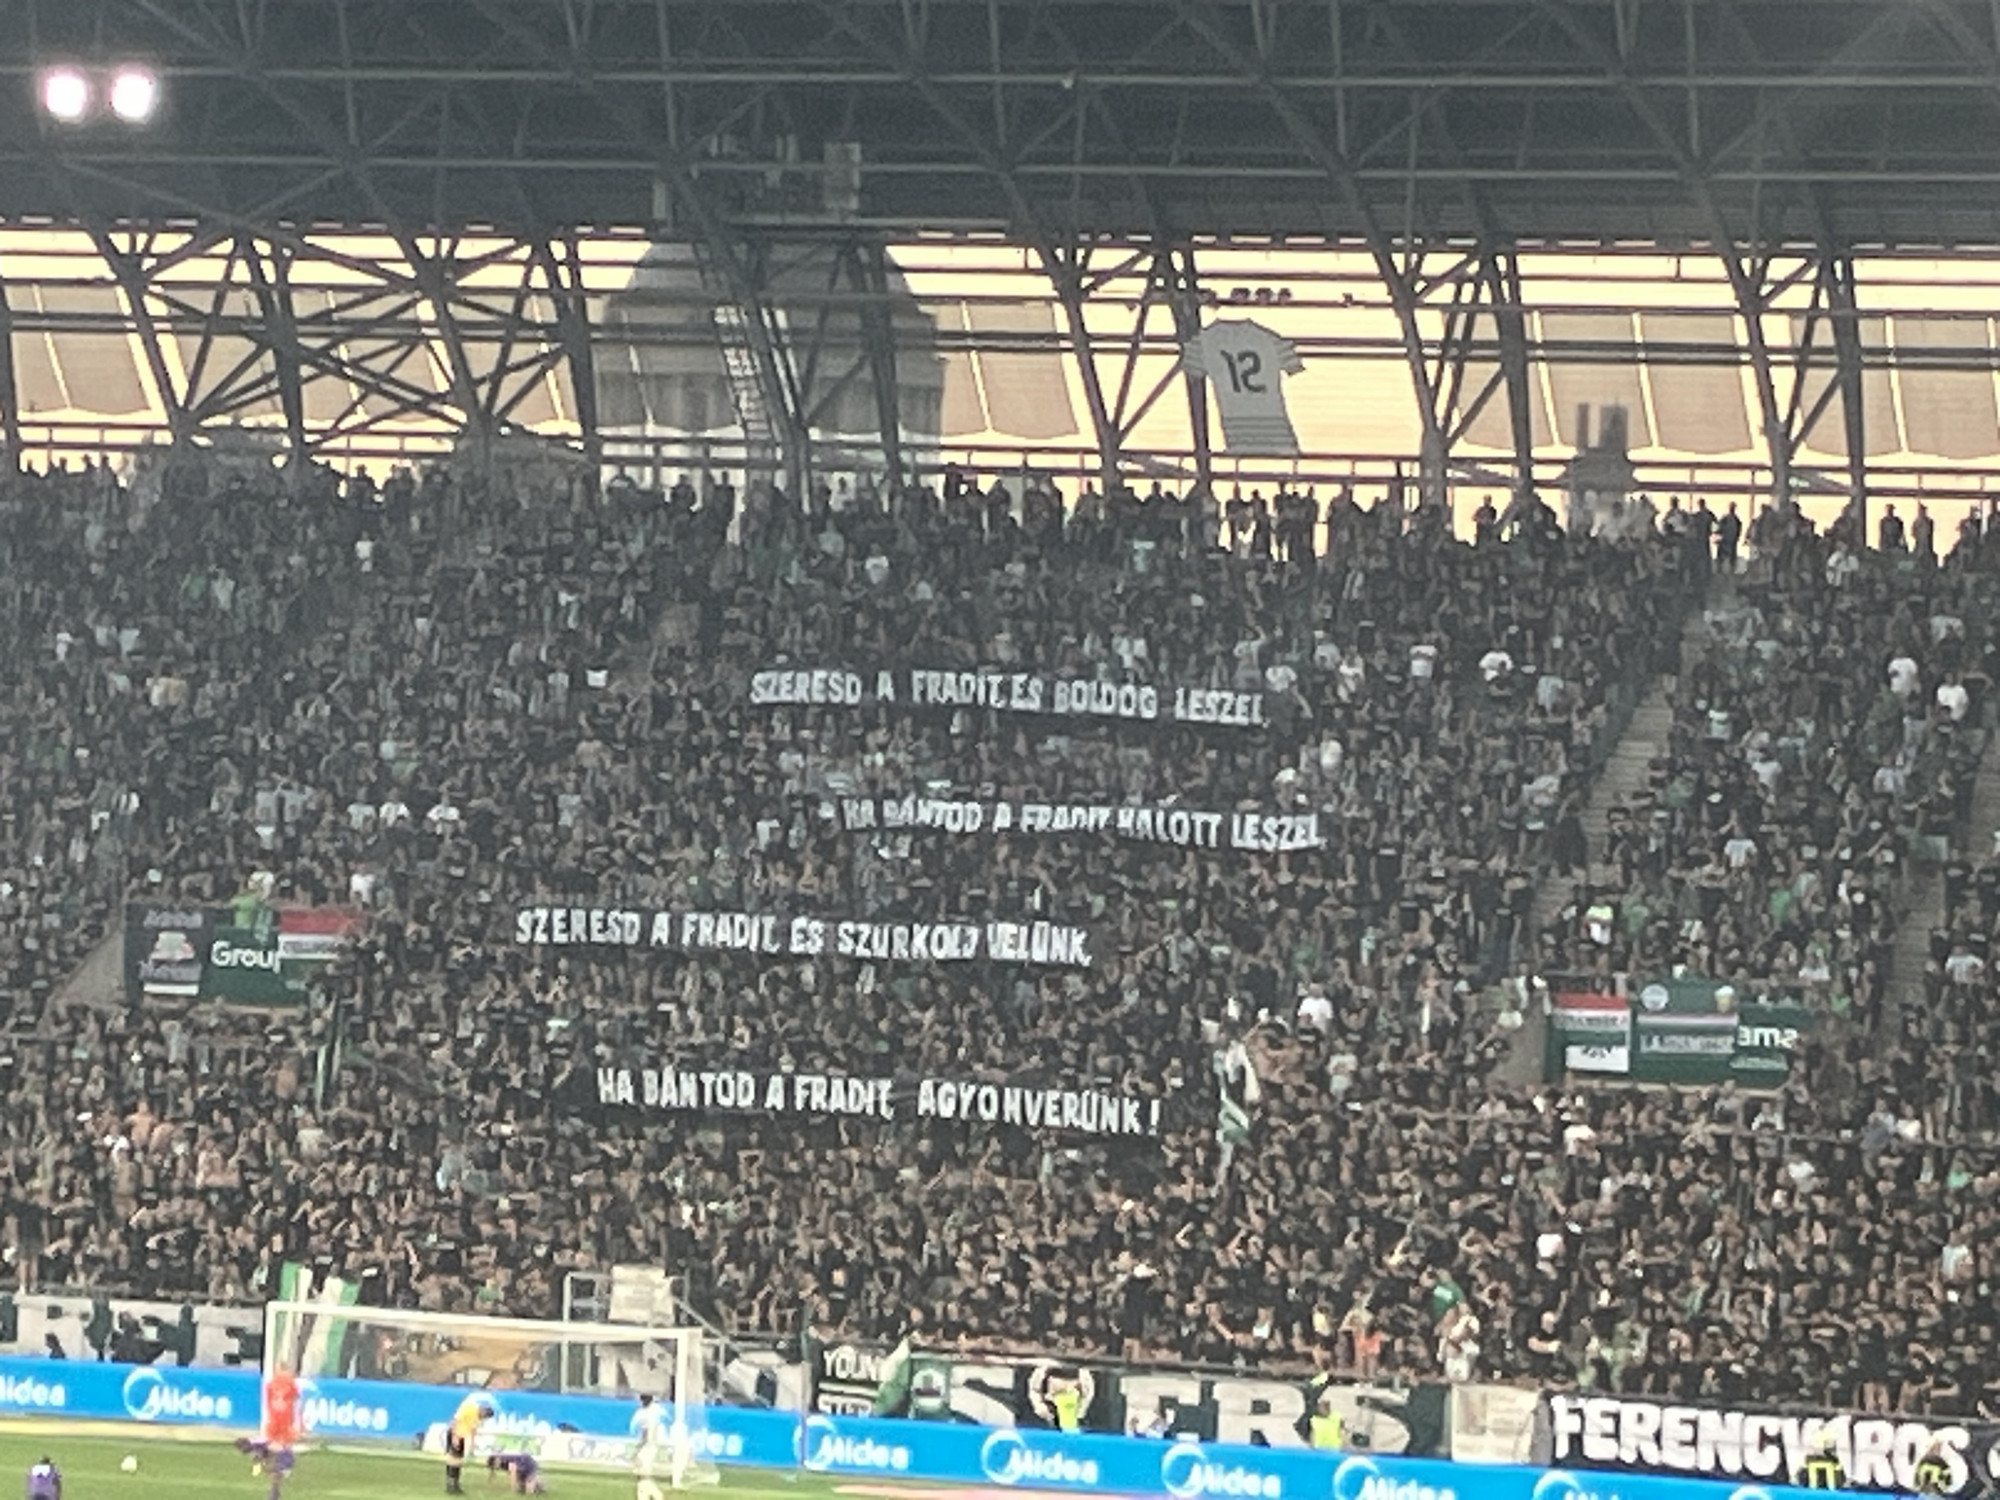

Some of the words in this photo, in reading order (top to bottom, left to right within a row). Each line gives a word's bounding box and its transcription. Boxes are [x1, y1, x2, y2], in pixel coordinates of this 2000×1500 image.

[1221, 350, 1266, 393] 12
[751, 670, 862, 704] SZERESD
[876, 671, 896, 701] A
[1054, 680, 1158, 718] BOLDOG
[993, 802, 1012, 833] A
[516, 908, 641, 945] SZERESD
[650, 911, 670, 946] A
[598, 1067, 635, 1105] HA
[764, 1075, 784, 1111] A
[148, 1384, 232, 1419] Midea
[303, 1397, 388, 1431] Midea
[816, 1434, 909, 1470] Midea
[1005, 1449, 1098, 1483] Midea
[1189, 1462, 1281, 1497] Midea
